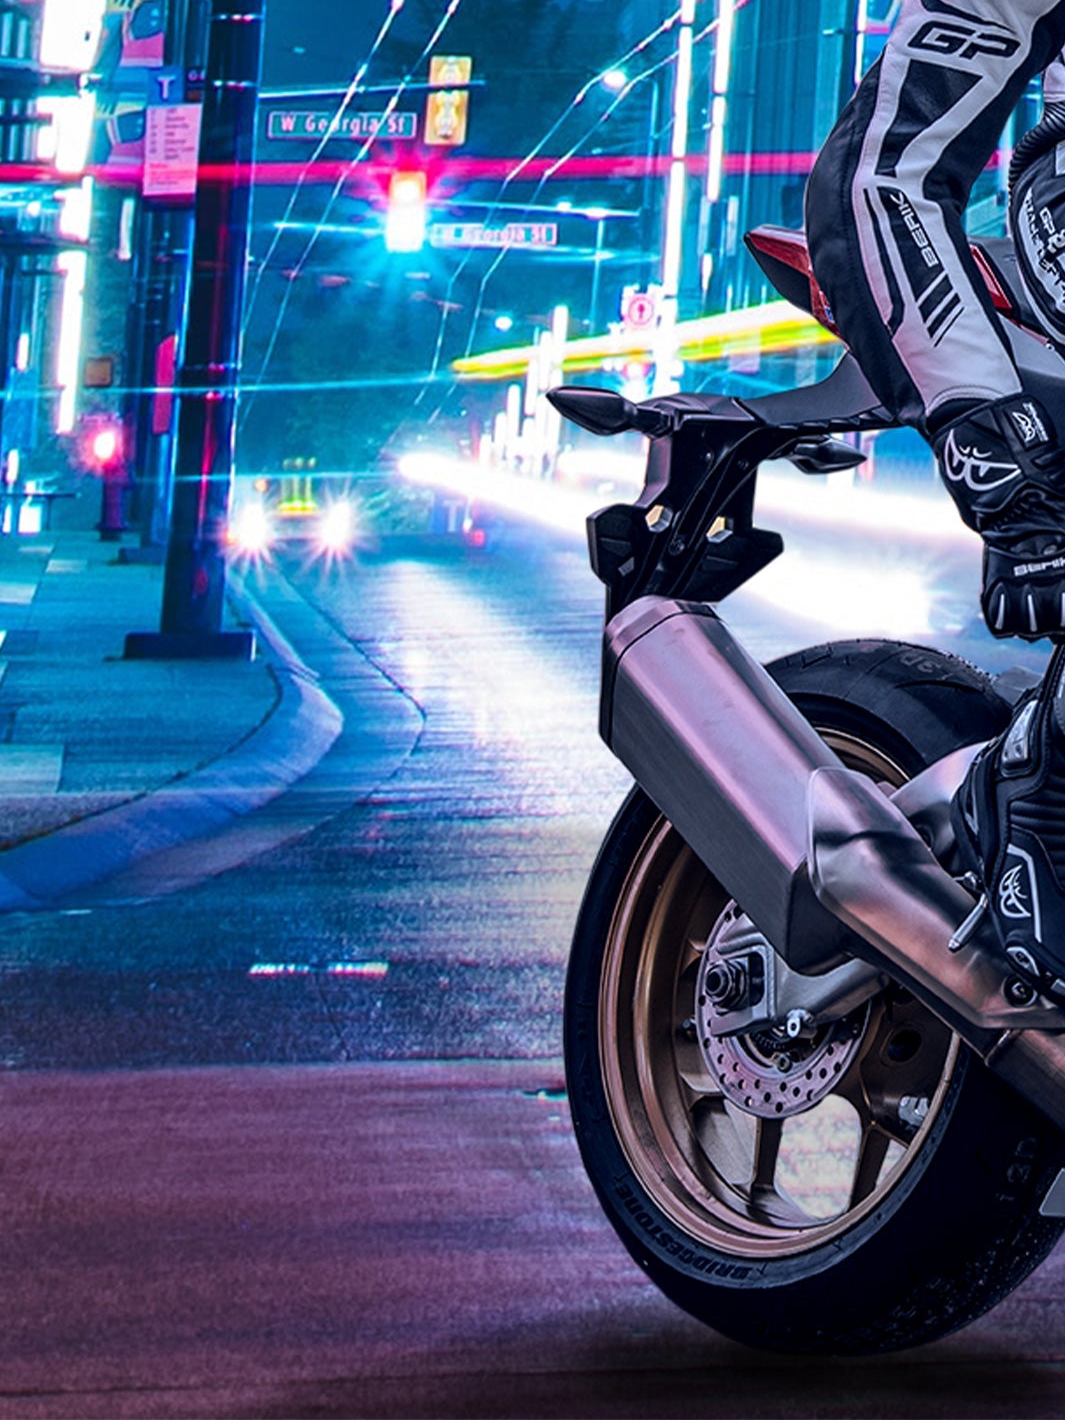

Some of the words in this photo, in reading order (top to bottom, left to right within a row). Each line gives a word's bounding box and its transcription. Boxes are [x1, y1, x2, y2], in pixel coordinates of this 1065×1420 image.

[907, 21, 1021, 60] GP
[281, 115, 296, 132] W
[305, 115, 380, 136] Georgia
[387, 115, 404, 132] St
[615, 1183, 753, 1280] BRIDGESTONE
